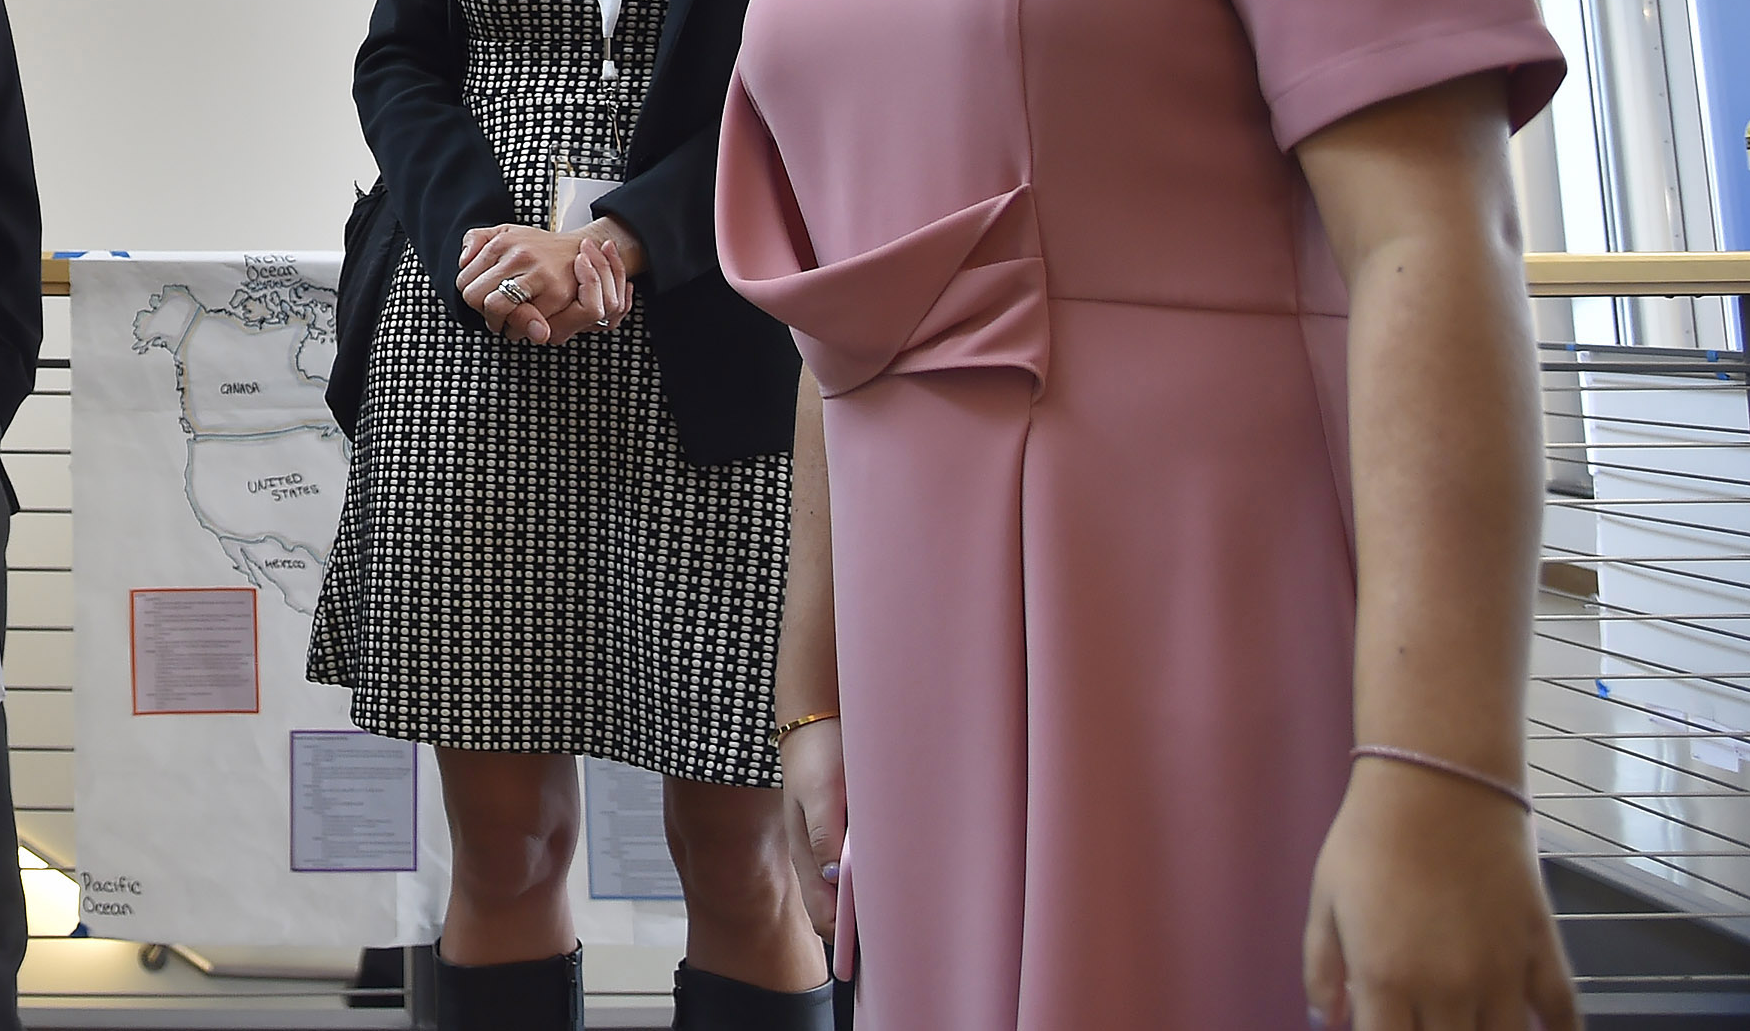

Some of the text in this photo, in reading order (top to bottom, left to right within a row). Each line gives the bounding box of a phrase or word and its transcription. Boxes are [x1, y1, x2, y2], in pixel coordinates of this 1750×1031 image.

[246, 265, 299, 281] Ocean
[220, 382, 261, 395] CANADA
[247, 473, 303, 494] UNITED
[81, 871, 142, 895] Pacific
[82, 896, 134, 916] Ocean
